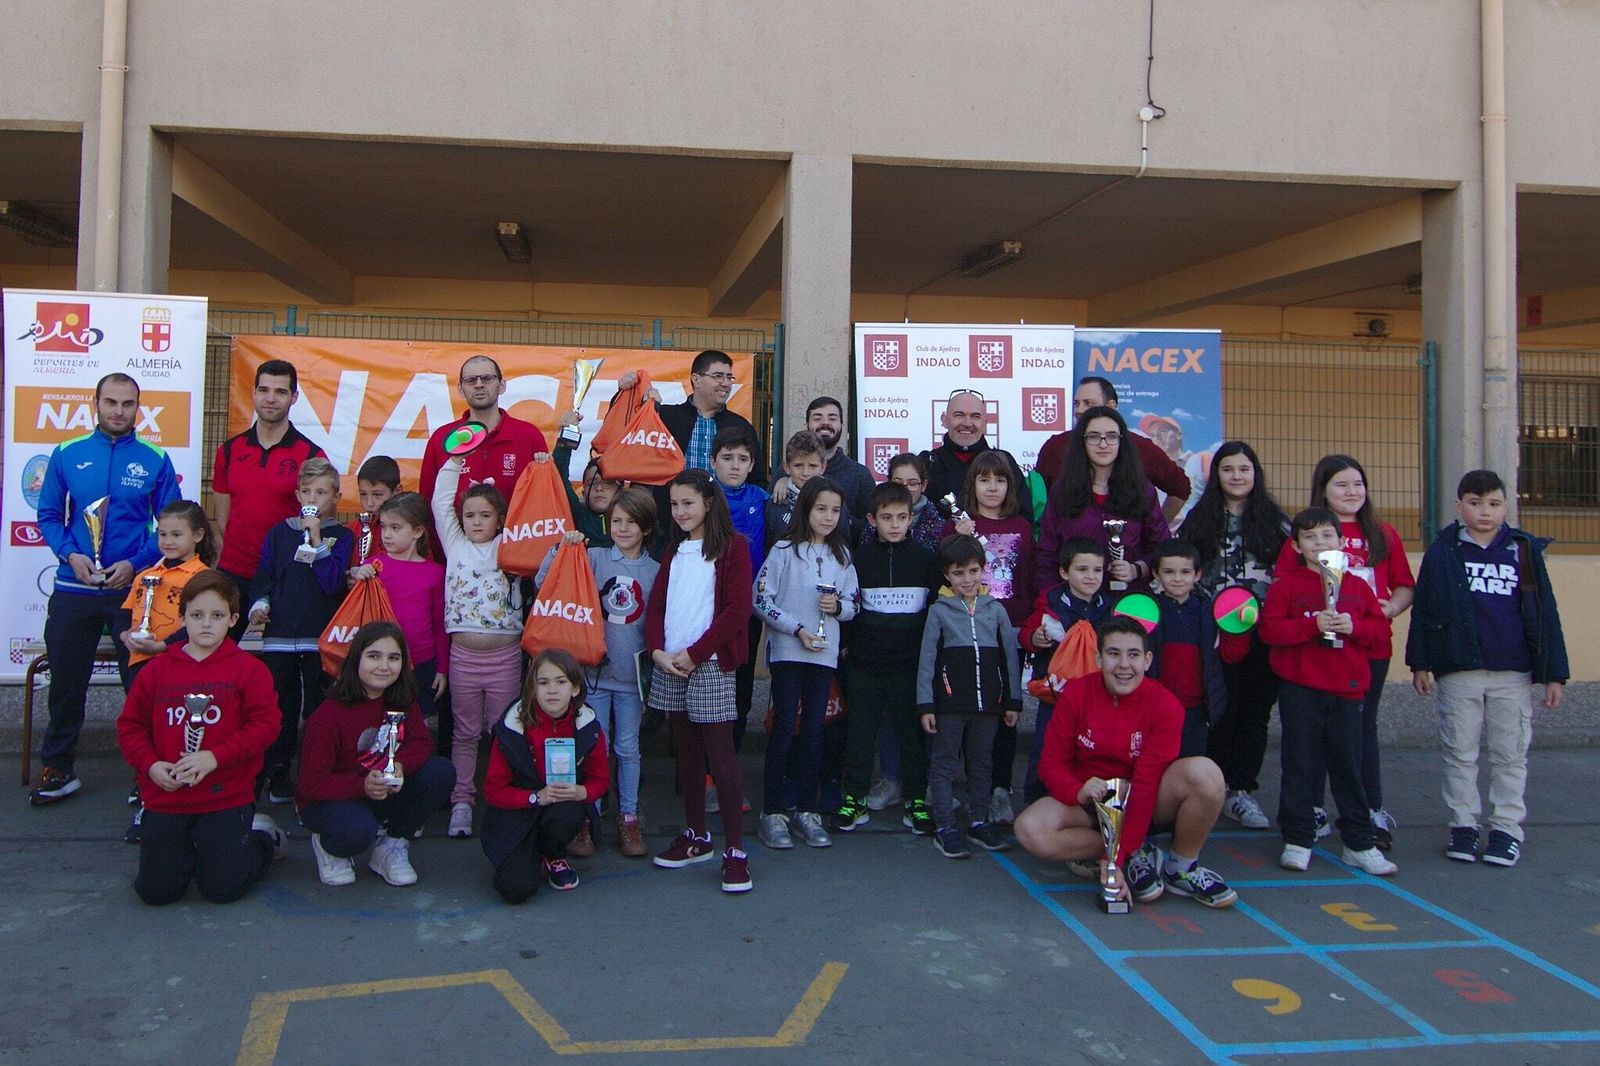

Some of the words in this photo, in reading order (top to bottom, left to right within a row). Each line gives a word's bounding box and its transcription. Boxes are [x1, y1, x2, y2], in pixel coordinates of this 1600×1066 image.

[938, 346, 960, 354] Ajedrez
[1043, 347, 1065, 355] Ajedrez
[126, 356, 182, 370] ALMERÍA
[915, 357, 961, 367] INDALO
[1021, 358, 1065, 368] INDALO
[1087, 347, 1206, 374] NACEX
[141, 370, 171, 378] CIUDAD
[887, 397, 909, 405] Ajedrez
[36, 402, 165, 434] NAX
[864, 408, 909, 418] INDALO
[620, 429, 677, 451] NACEX
[502, 518, 567, 544] NACEX
[1467, 576, 1518, 596] ARS
[24, 603, 46, 612] GRA
[532, 599, 595, 625] NACEX
[166, 704, 222, 726] 190
